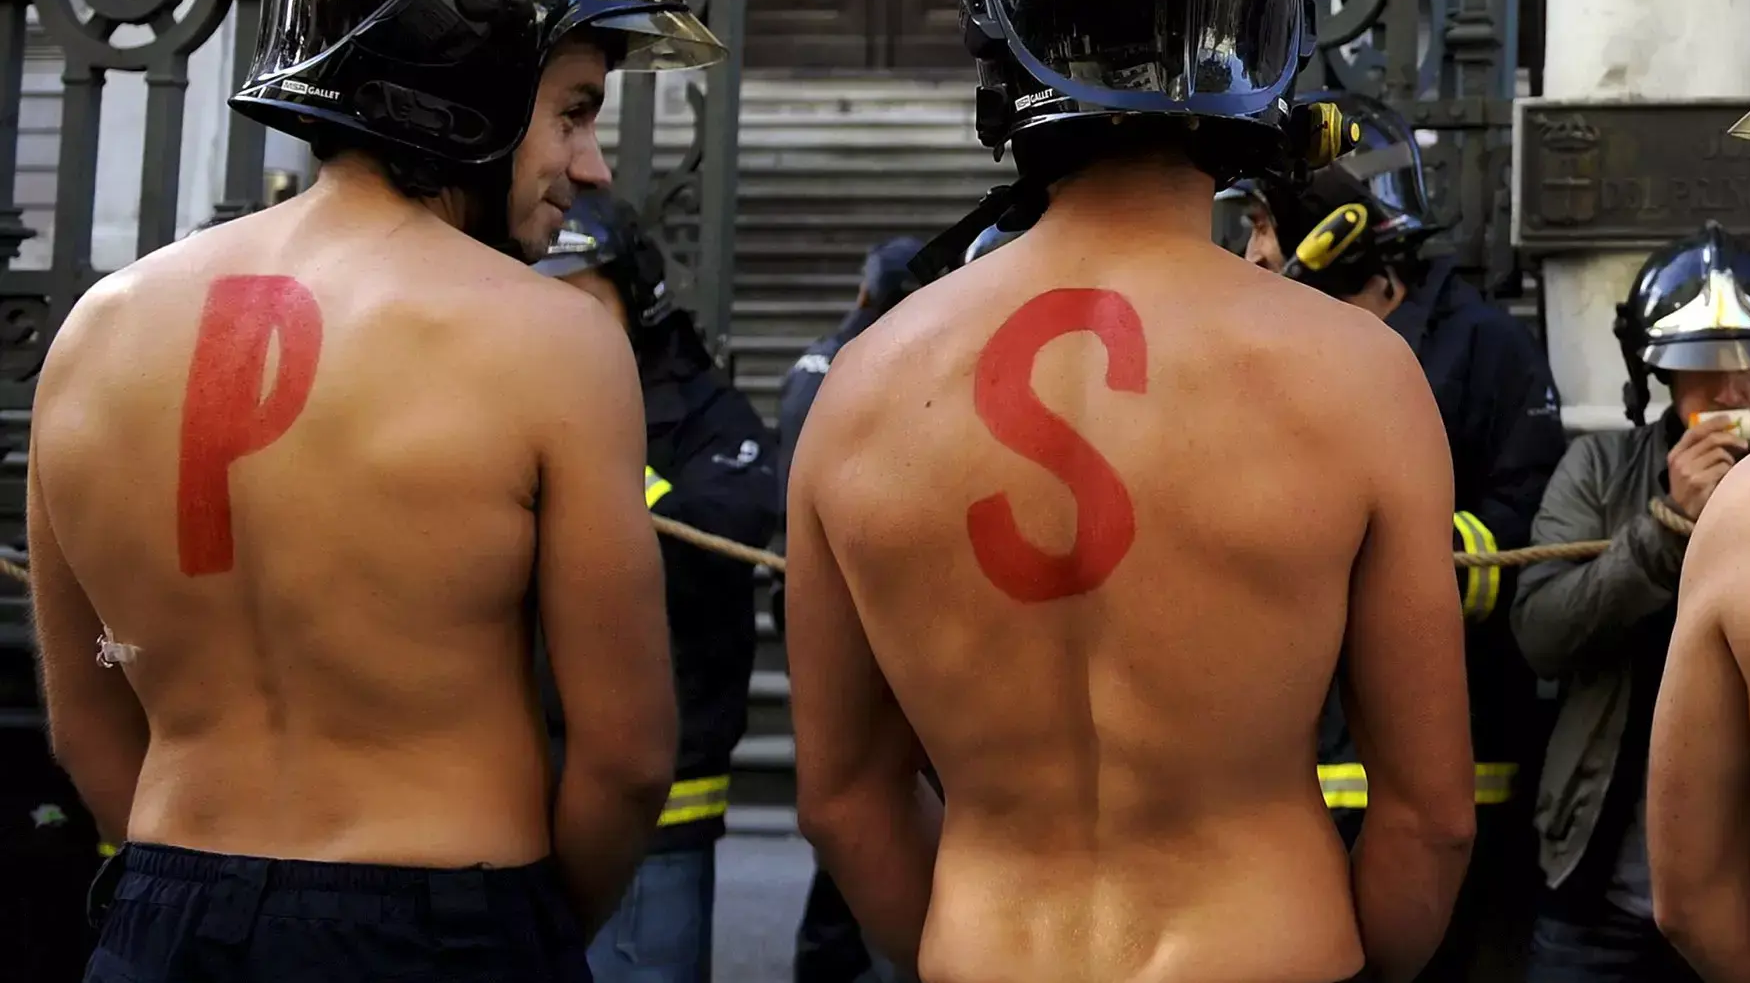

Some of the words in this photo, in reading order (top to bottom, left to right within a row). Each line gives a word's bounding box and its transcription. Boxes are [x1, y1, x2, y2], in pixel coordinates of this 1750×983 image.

[307, 86, 340, 100] GALLET
[177, 275, 323, 577] P
[966, 288, 1147, 604] S
